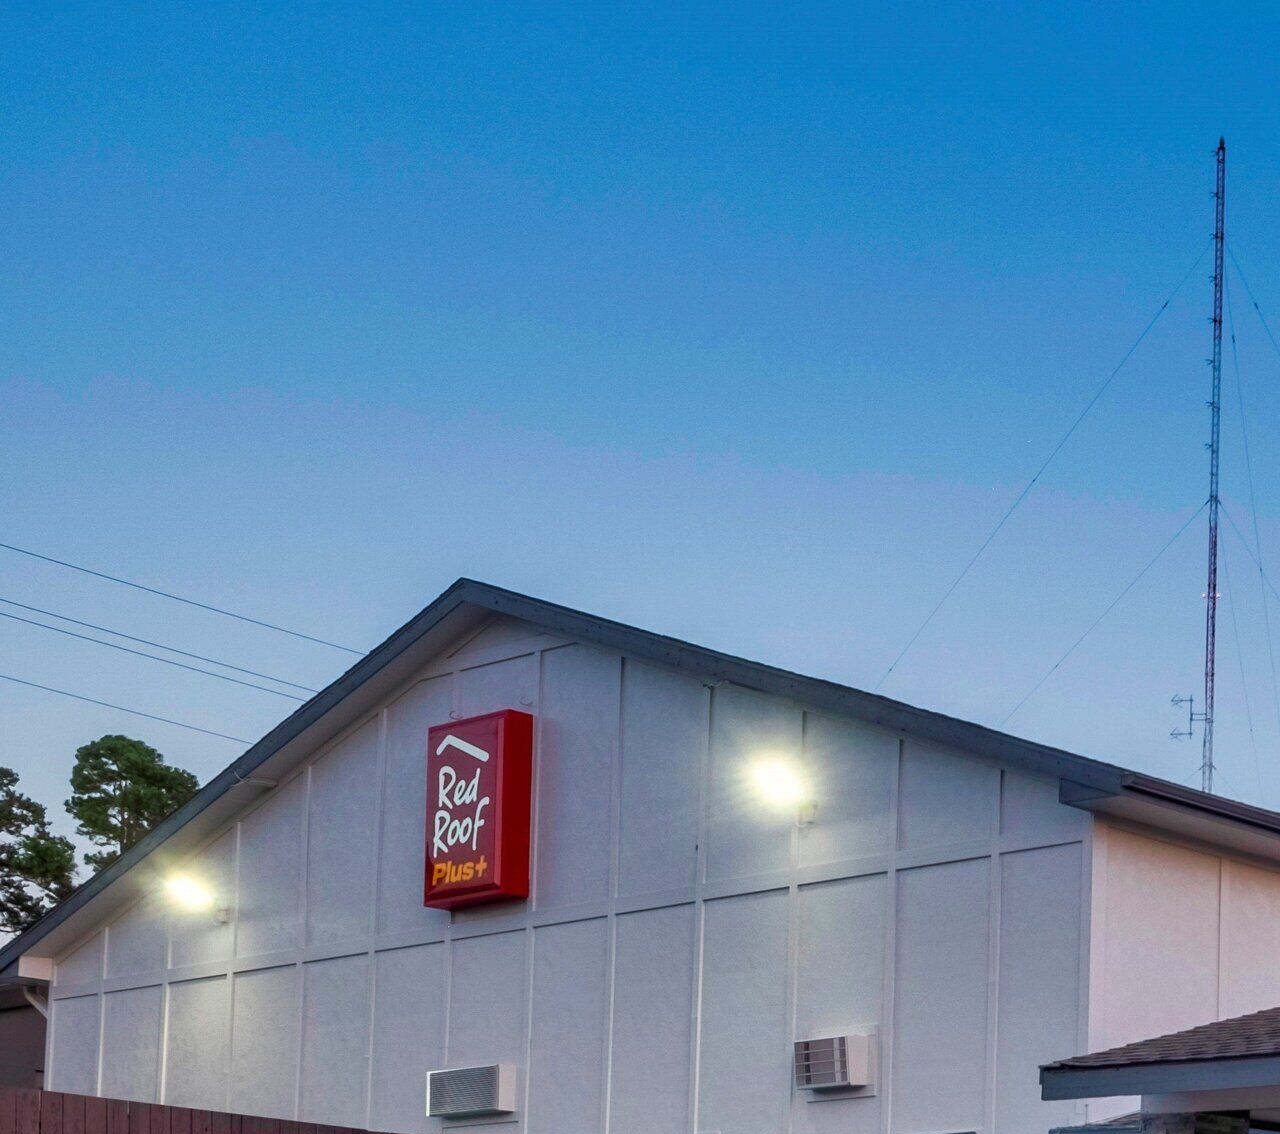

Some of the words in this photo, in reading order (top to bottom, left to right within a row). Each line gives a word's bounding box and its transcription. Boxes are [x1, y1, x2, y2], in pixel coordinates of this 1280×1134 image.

[439, 765, 480, 809] Red
[433, 797, 489, 858] Roof
[432, 855, 487, 885] Plus+
